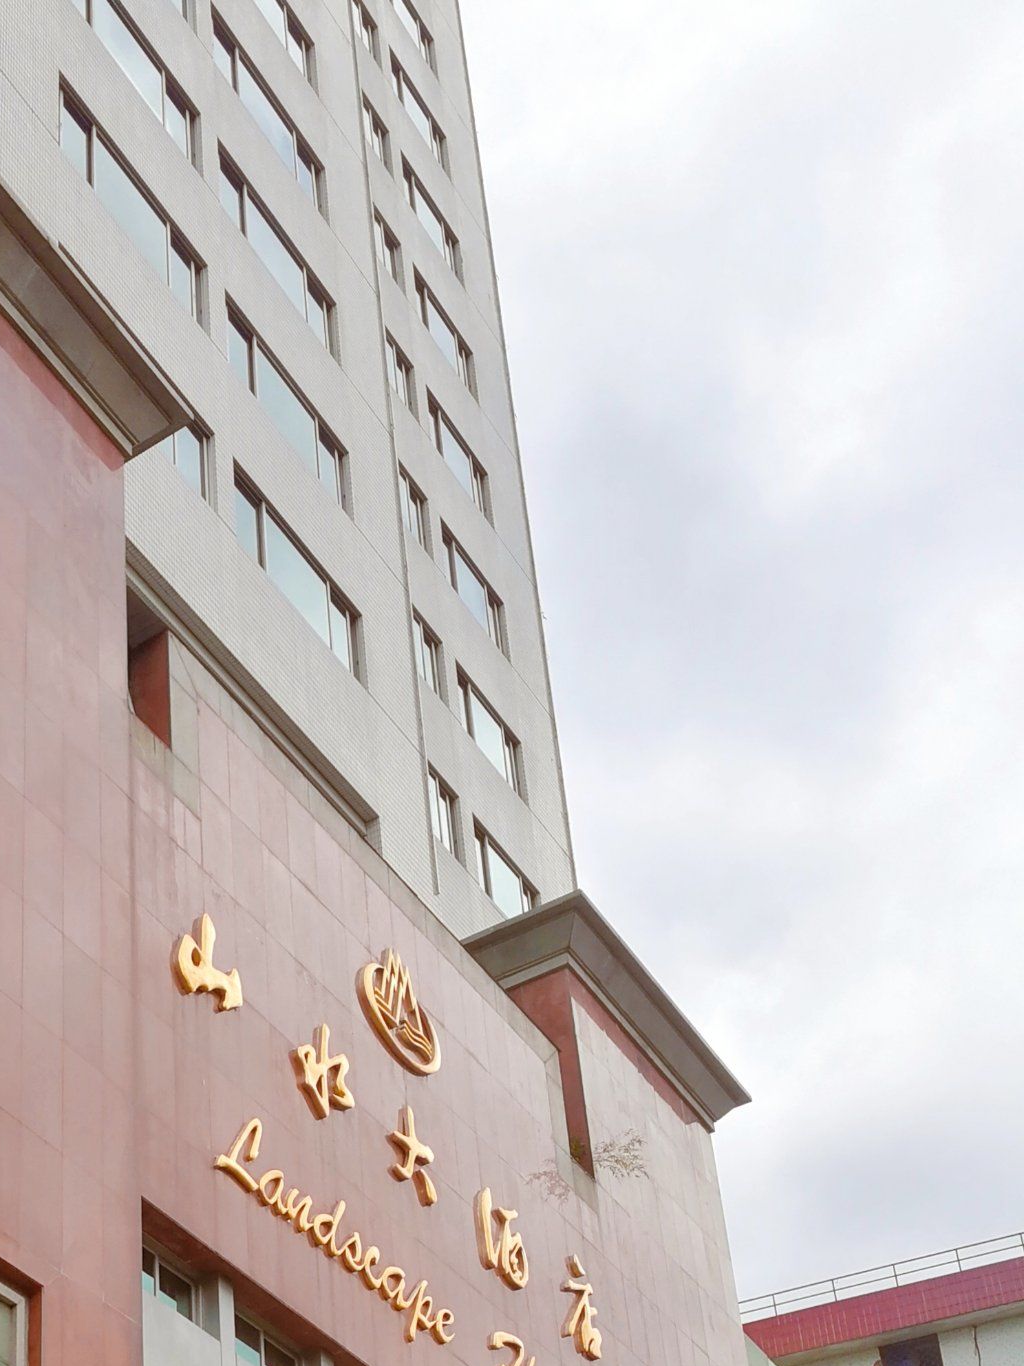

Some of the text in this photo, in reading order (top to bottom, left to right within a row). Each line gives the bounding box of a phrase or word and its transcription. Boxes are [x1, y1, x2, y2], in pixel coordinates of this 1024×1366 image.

[171, 913, 603, 1362] 山水大酒店
[214, 1117, 456, 1344] Landscape
